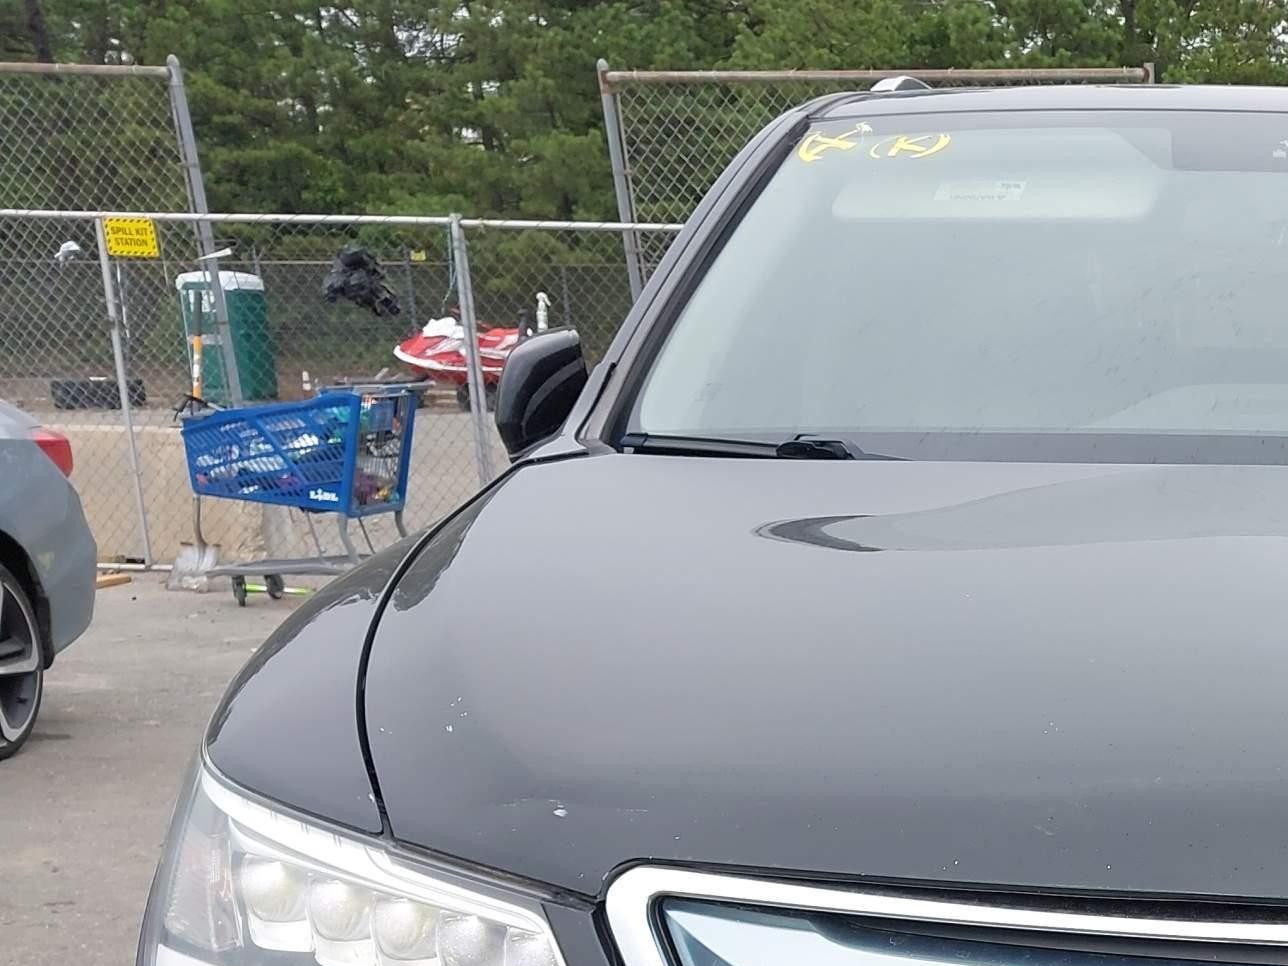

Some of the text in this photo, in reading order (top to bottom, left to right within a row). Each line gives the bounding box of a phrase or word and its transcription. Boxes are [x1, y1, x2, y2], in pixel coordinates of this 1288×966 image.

[110, 226, 148, 237] SPILL KIT
[114, 237, 149, 247] STATION
